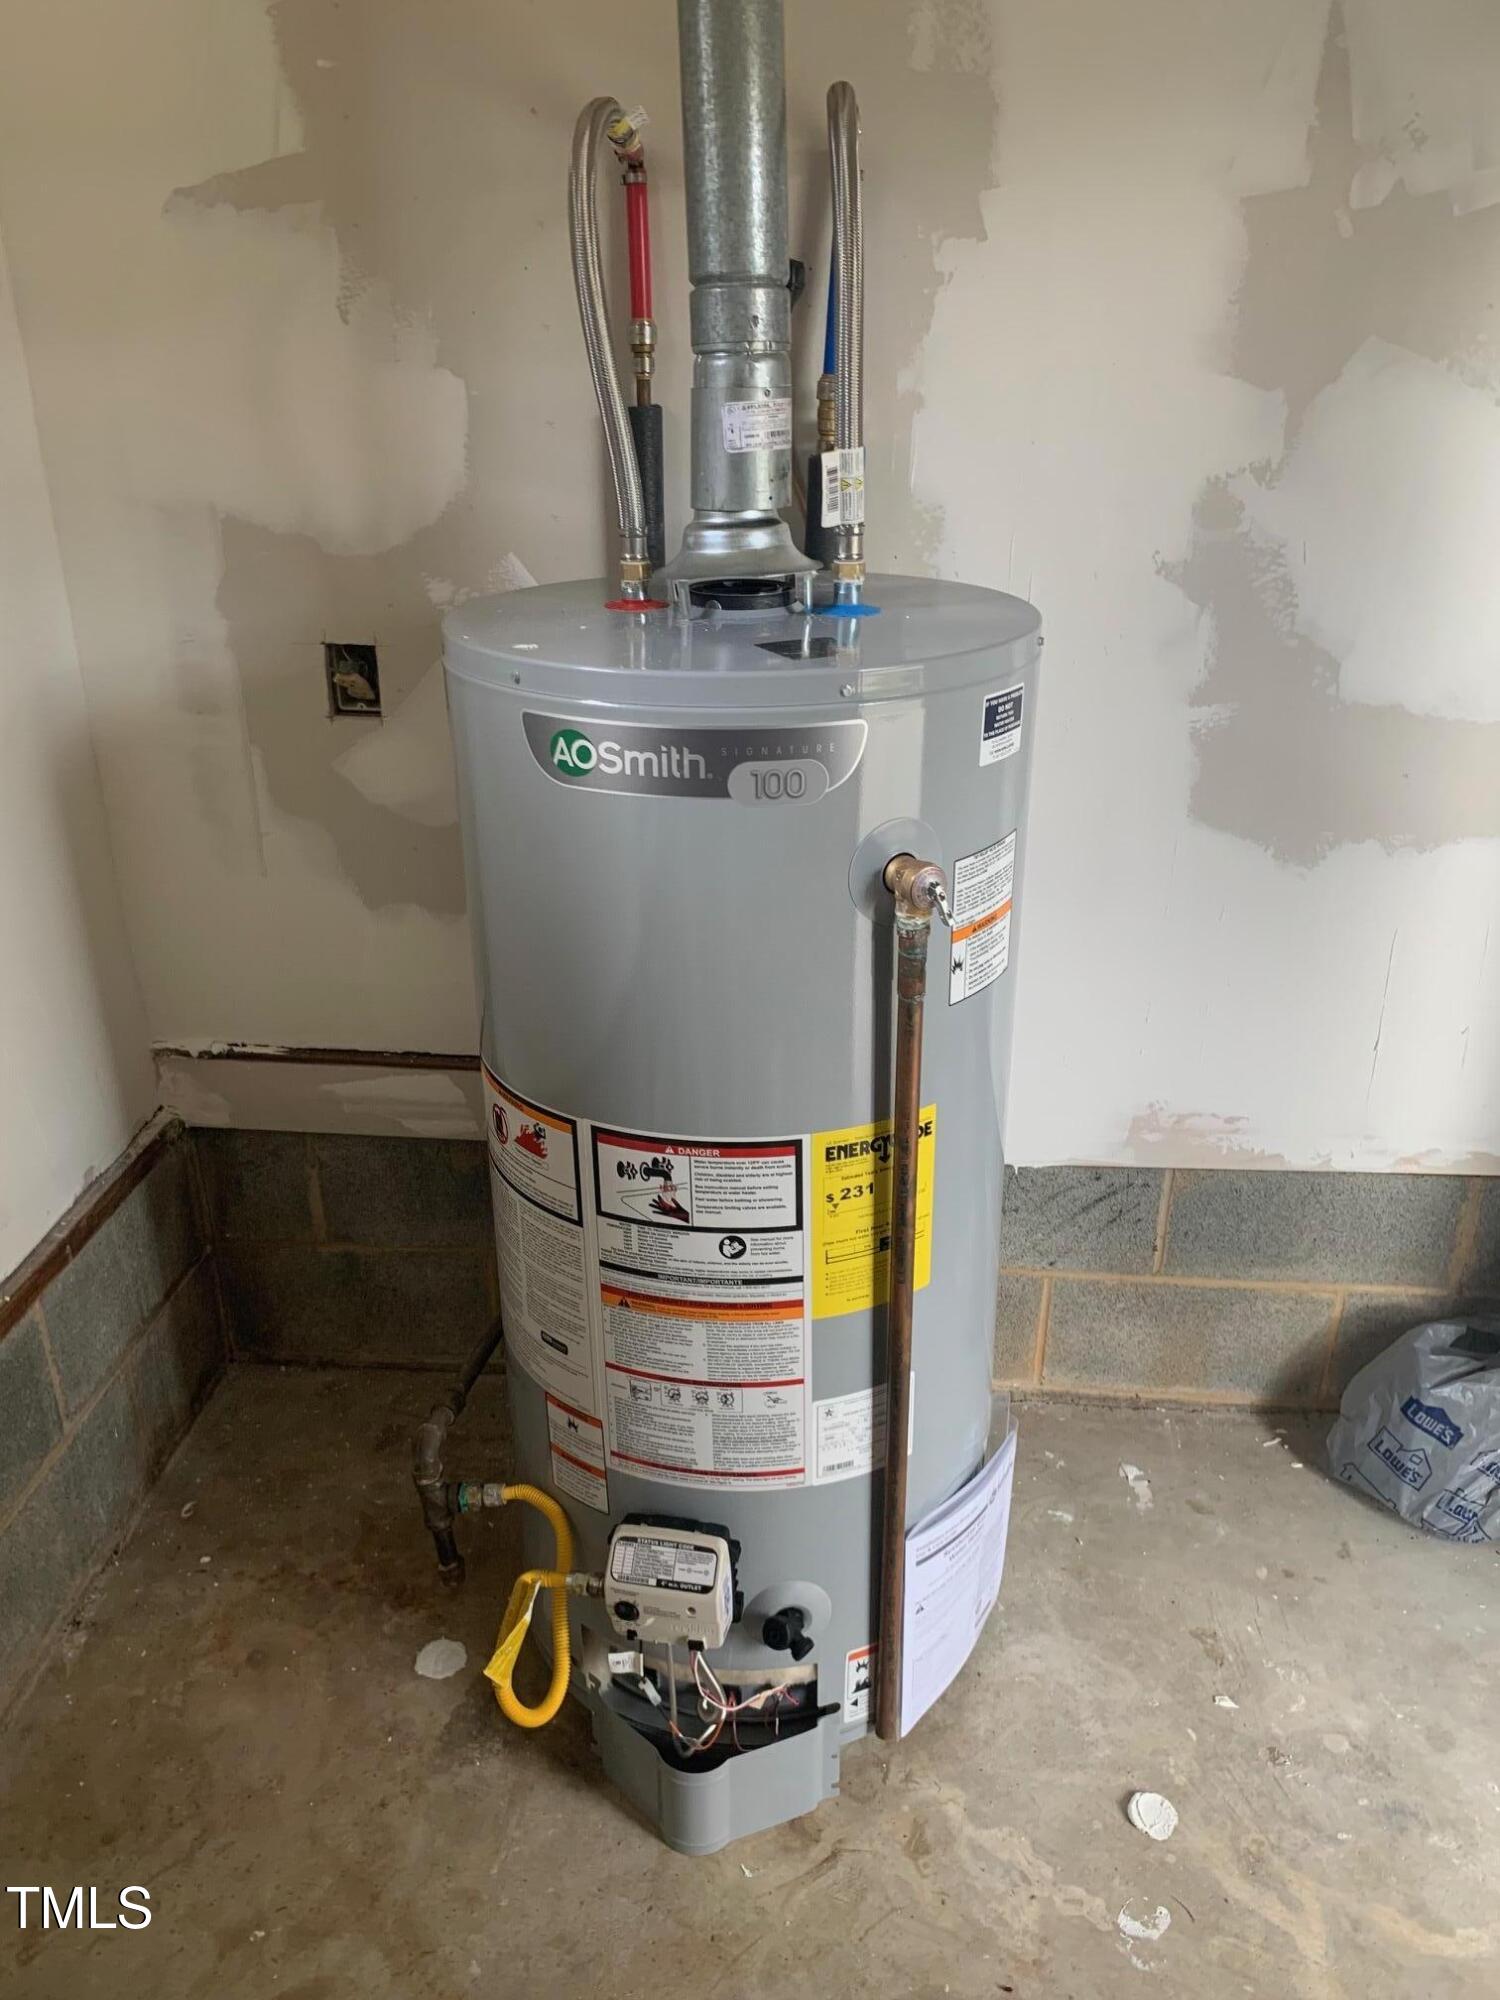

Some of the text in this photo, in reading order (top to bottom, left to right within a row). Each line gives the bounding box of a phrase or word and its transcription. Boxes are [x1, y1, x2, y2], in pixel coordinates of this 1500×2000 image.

[721, 742, 835, 757] SIGNATURE
[750, 768, 806, 800] 100
[678, 1147, 720, 1157] DANGER
[826, 1182, 874, 1203] $ 231
[1407, 1403, 1454, 1445] LOWE'S
[1374, 1439, 1423, 1483] LOWE'S
